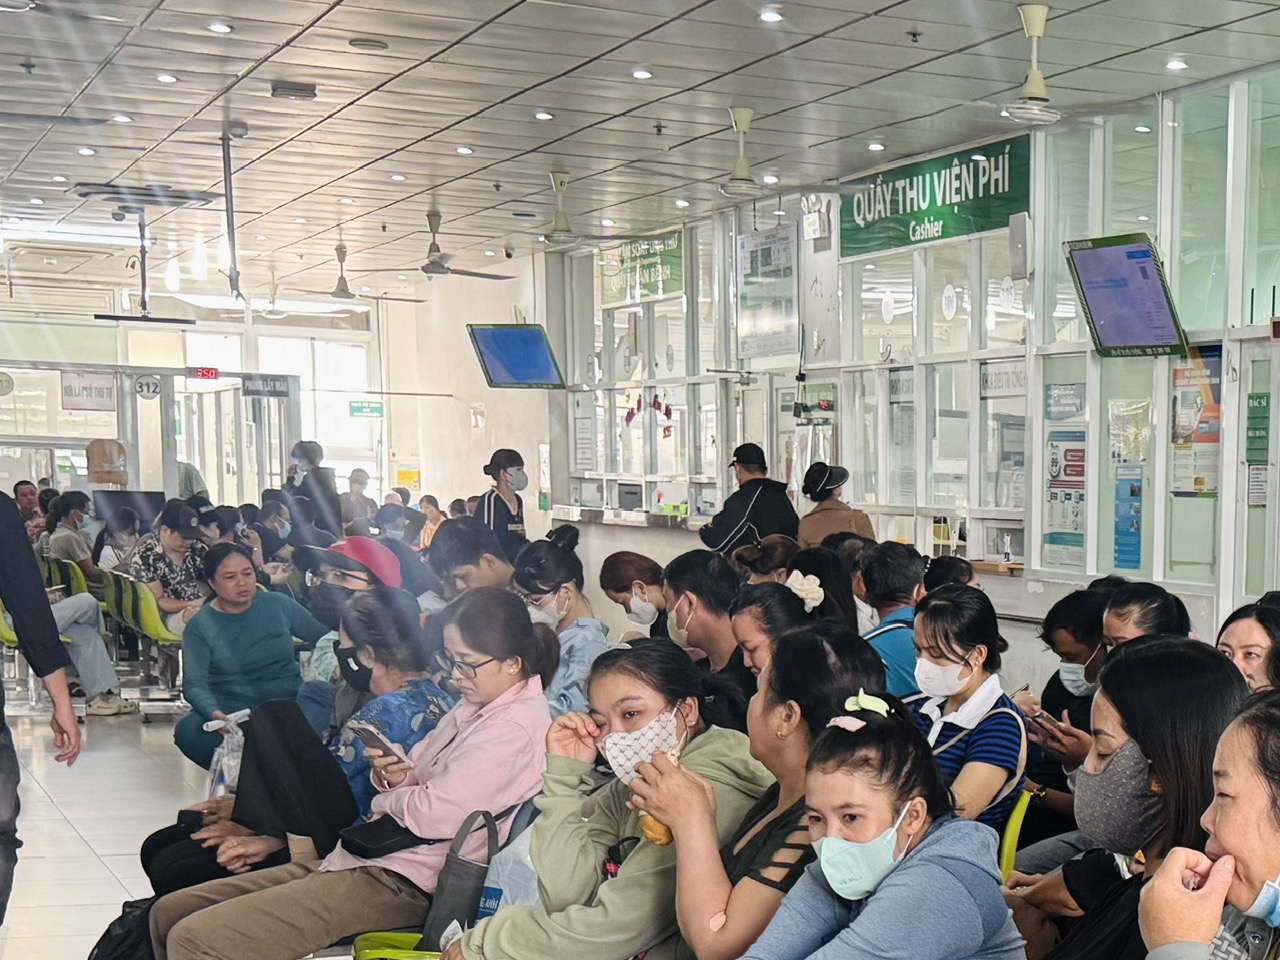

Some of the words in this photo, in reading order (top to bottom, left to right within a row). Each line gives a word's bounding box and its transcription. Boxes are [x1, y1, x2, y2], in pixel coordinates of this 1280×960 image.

[895, 173, 931, 214] THU
[933, 158, 974, 213] VIỆN
[978, 145, 1010, 197] PHÍ
[909, 215, 943, 242] Cashier
[137, 382, 159, 394] 312
